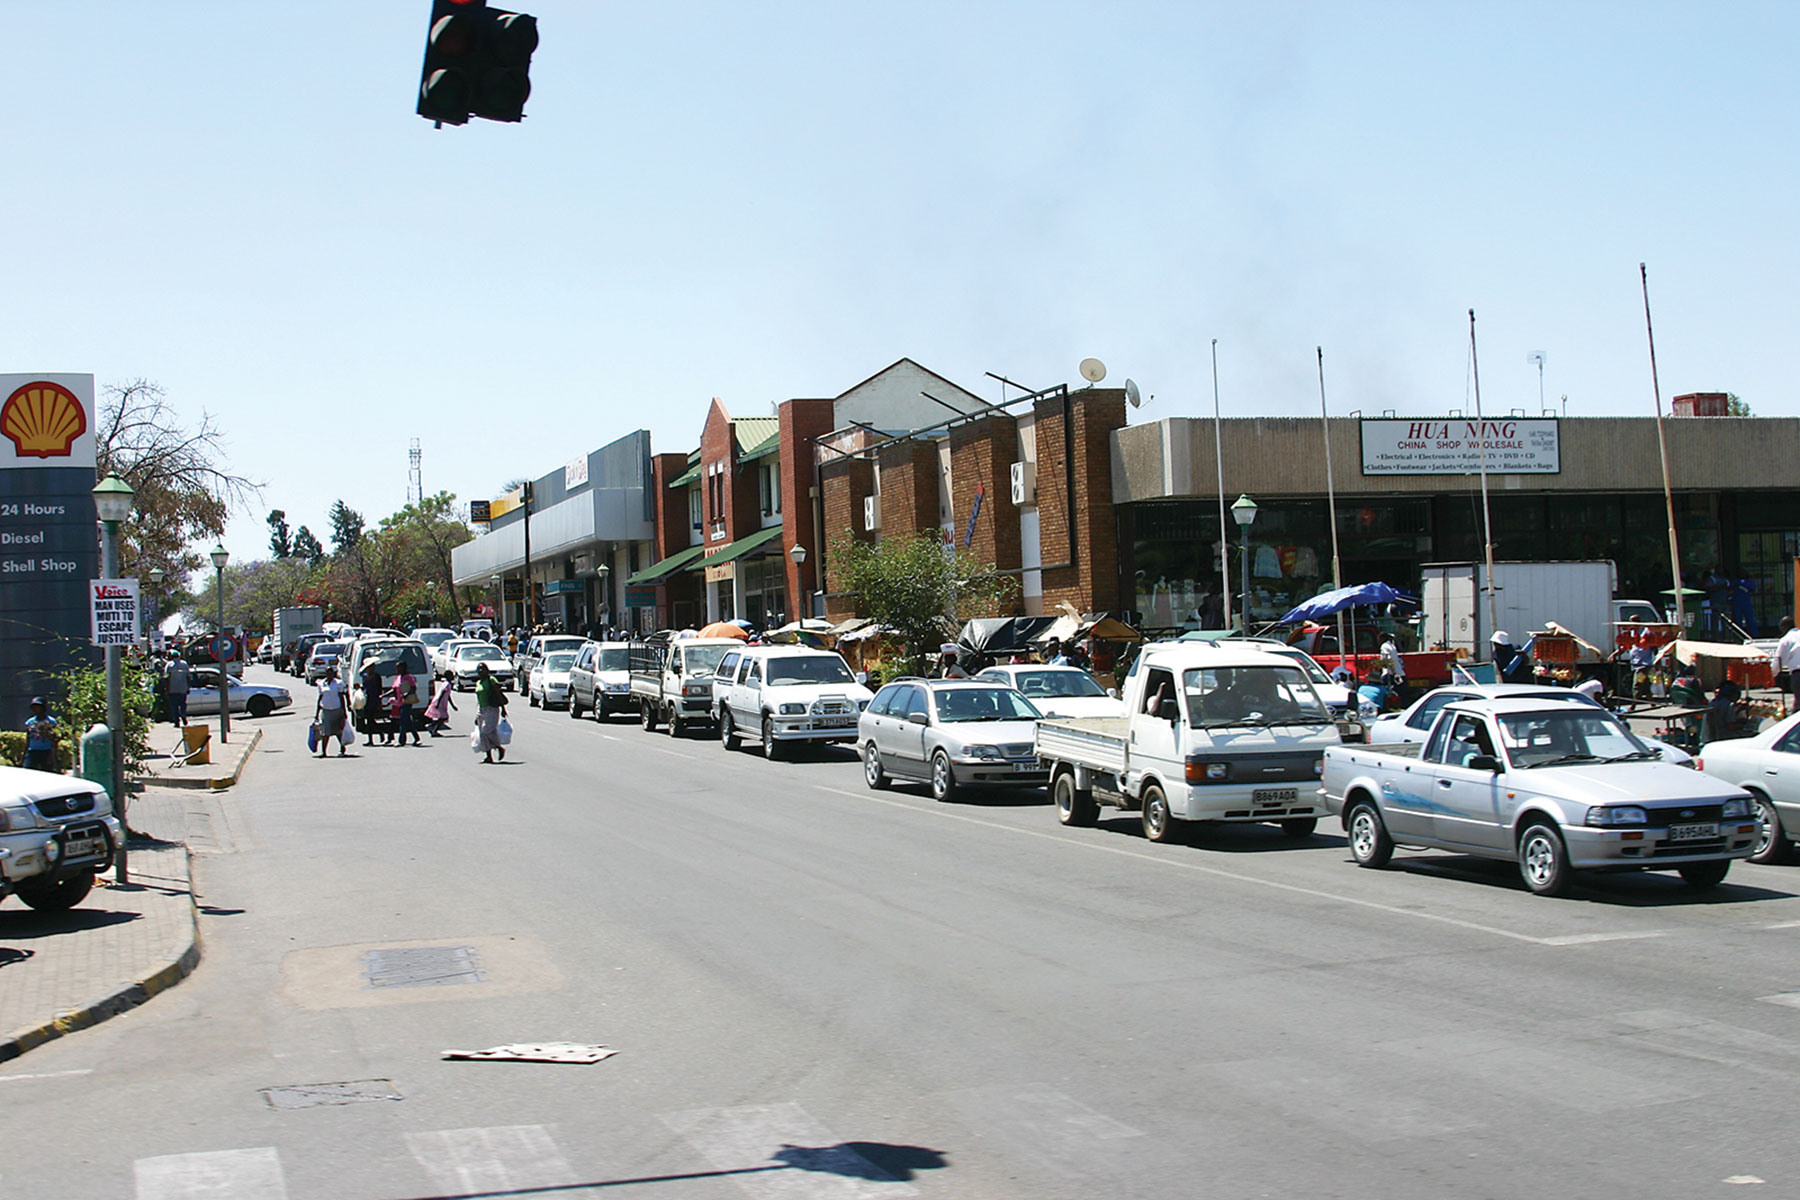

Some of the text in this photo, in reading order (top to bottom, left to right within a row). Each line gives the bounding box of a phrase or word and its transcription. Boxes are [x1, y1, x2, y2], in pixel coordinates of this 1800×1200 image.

[1407, 421, 1517, 440] HUA NING
[1397, 440, 1428, 450] CHINA
[1436, 440, 1462, 449] SHOP
[0, 503, 66, 516] 24 Hours
[1, 530, 45, 545] Diesel
[2, 558, 77, 573] Shell Shop
[95, 585, 128, 599] Voice
[95, 600, 136, 610] MAN USES
[96, 611, 134, 621] MUTI TO
[98, 622, 133, 632] ESCAPE
[97, 633, 135, 643] JUSTICE
